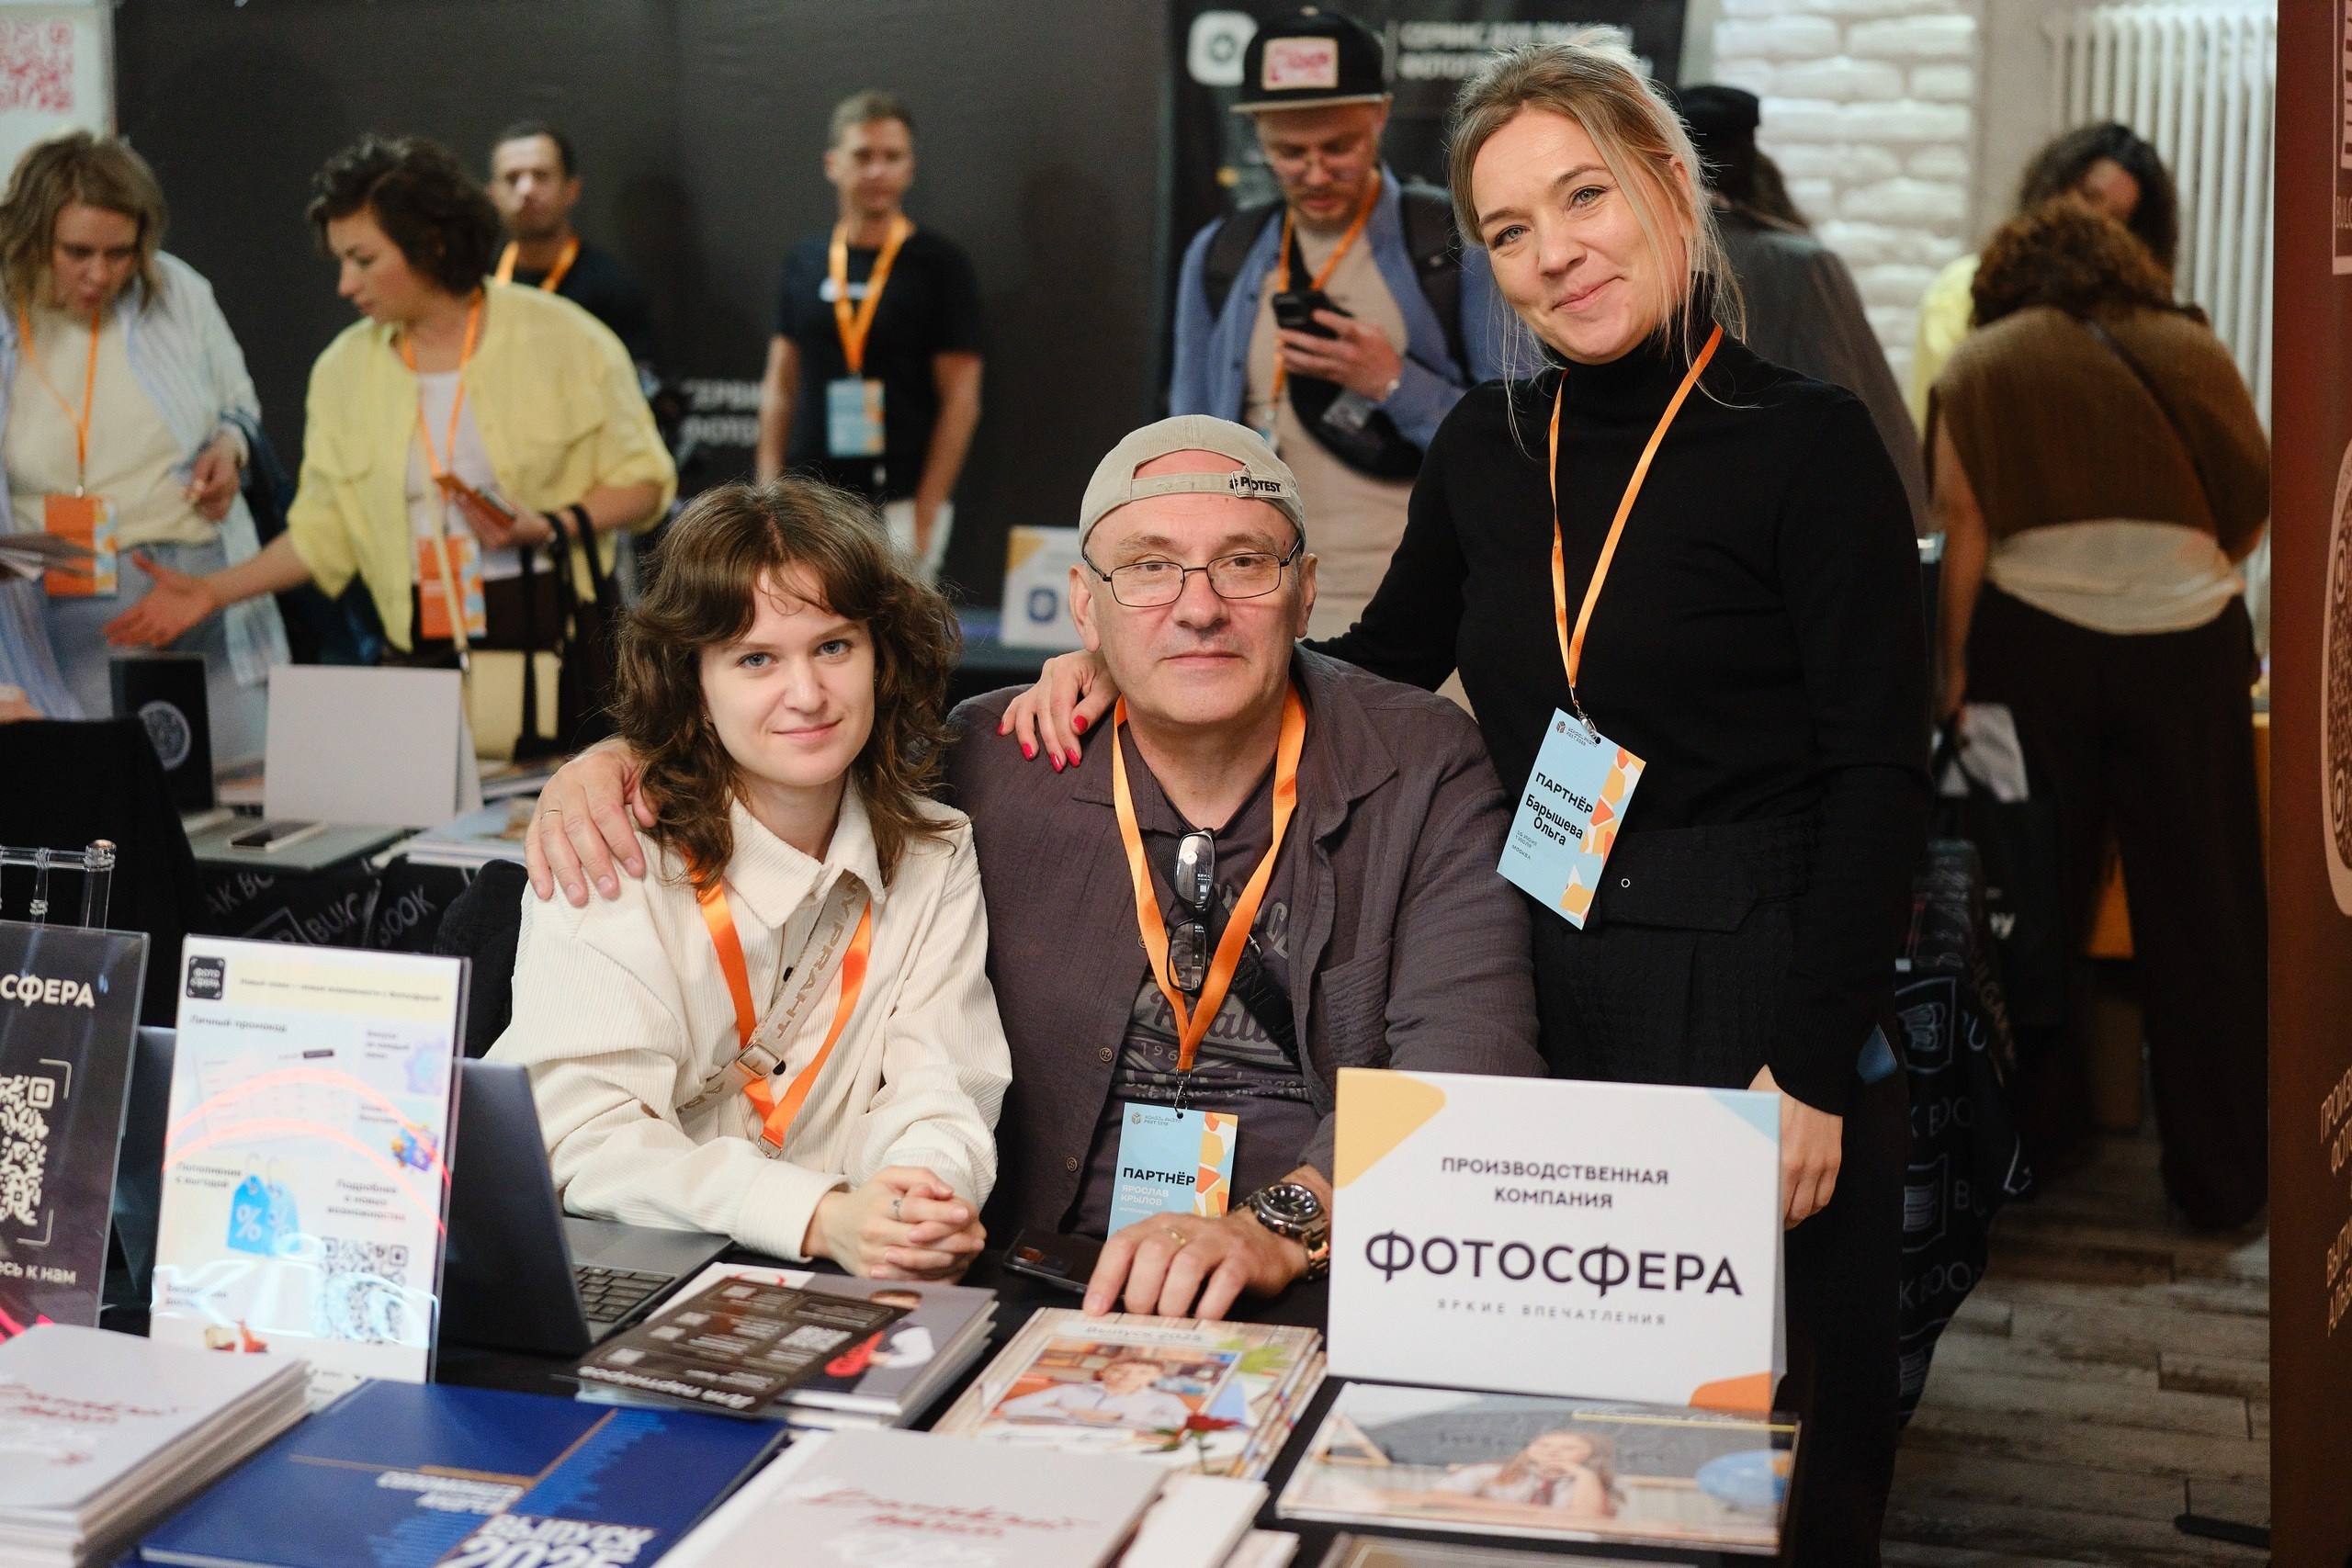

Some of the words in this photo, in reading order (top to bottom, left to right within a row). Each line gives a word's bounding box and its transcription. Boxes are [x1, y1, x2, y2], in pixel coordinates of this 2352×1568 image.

[1535, 772, 1593, 814] ПАРТНЁР
[1525, 794, 1583, 840] Барышева
[1533, 817, 1566, 846] Ольга
[0, 974, 96, 1009] СФЕРА
[188, 1013, 230, 1026] Личный
[235, 1020, 288, 1032] промокод
[1141, 1042, 1178, 1062] 196
[1123, 1168, 1196, 1186] ПАРТНЁР
[1442, 1156, 1668, 1186] ПРОИЗВОДСТВЕННАЯ
[1121, 1194, 1162, 1206] КРЫЛОВ
[1122, 1184, 1170, 1198] ЯРОСЛАВ
[1494, 1187, 1613, 1209] КОМПАНИЯ
[1364, 1229, 1744, 1298] ФОТОСФЕРА
[1437, 1299, 1506, 1314] ЯРКИЕ
[1521, 1304, 1668, 1326] ВПЕЧАТЛЕНИЯ
